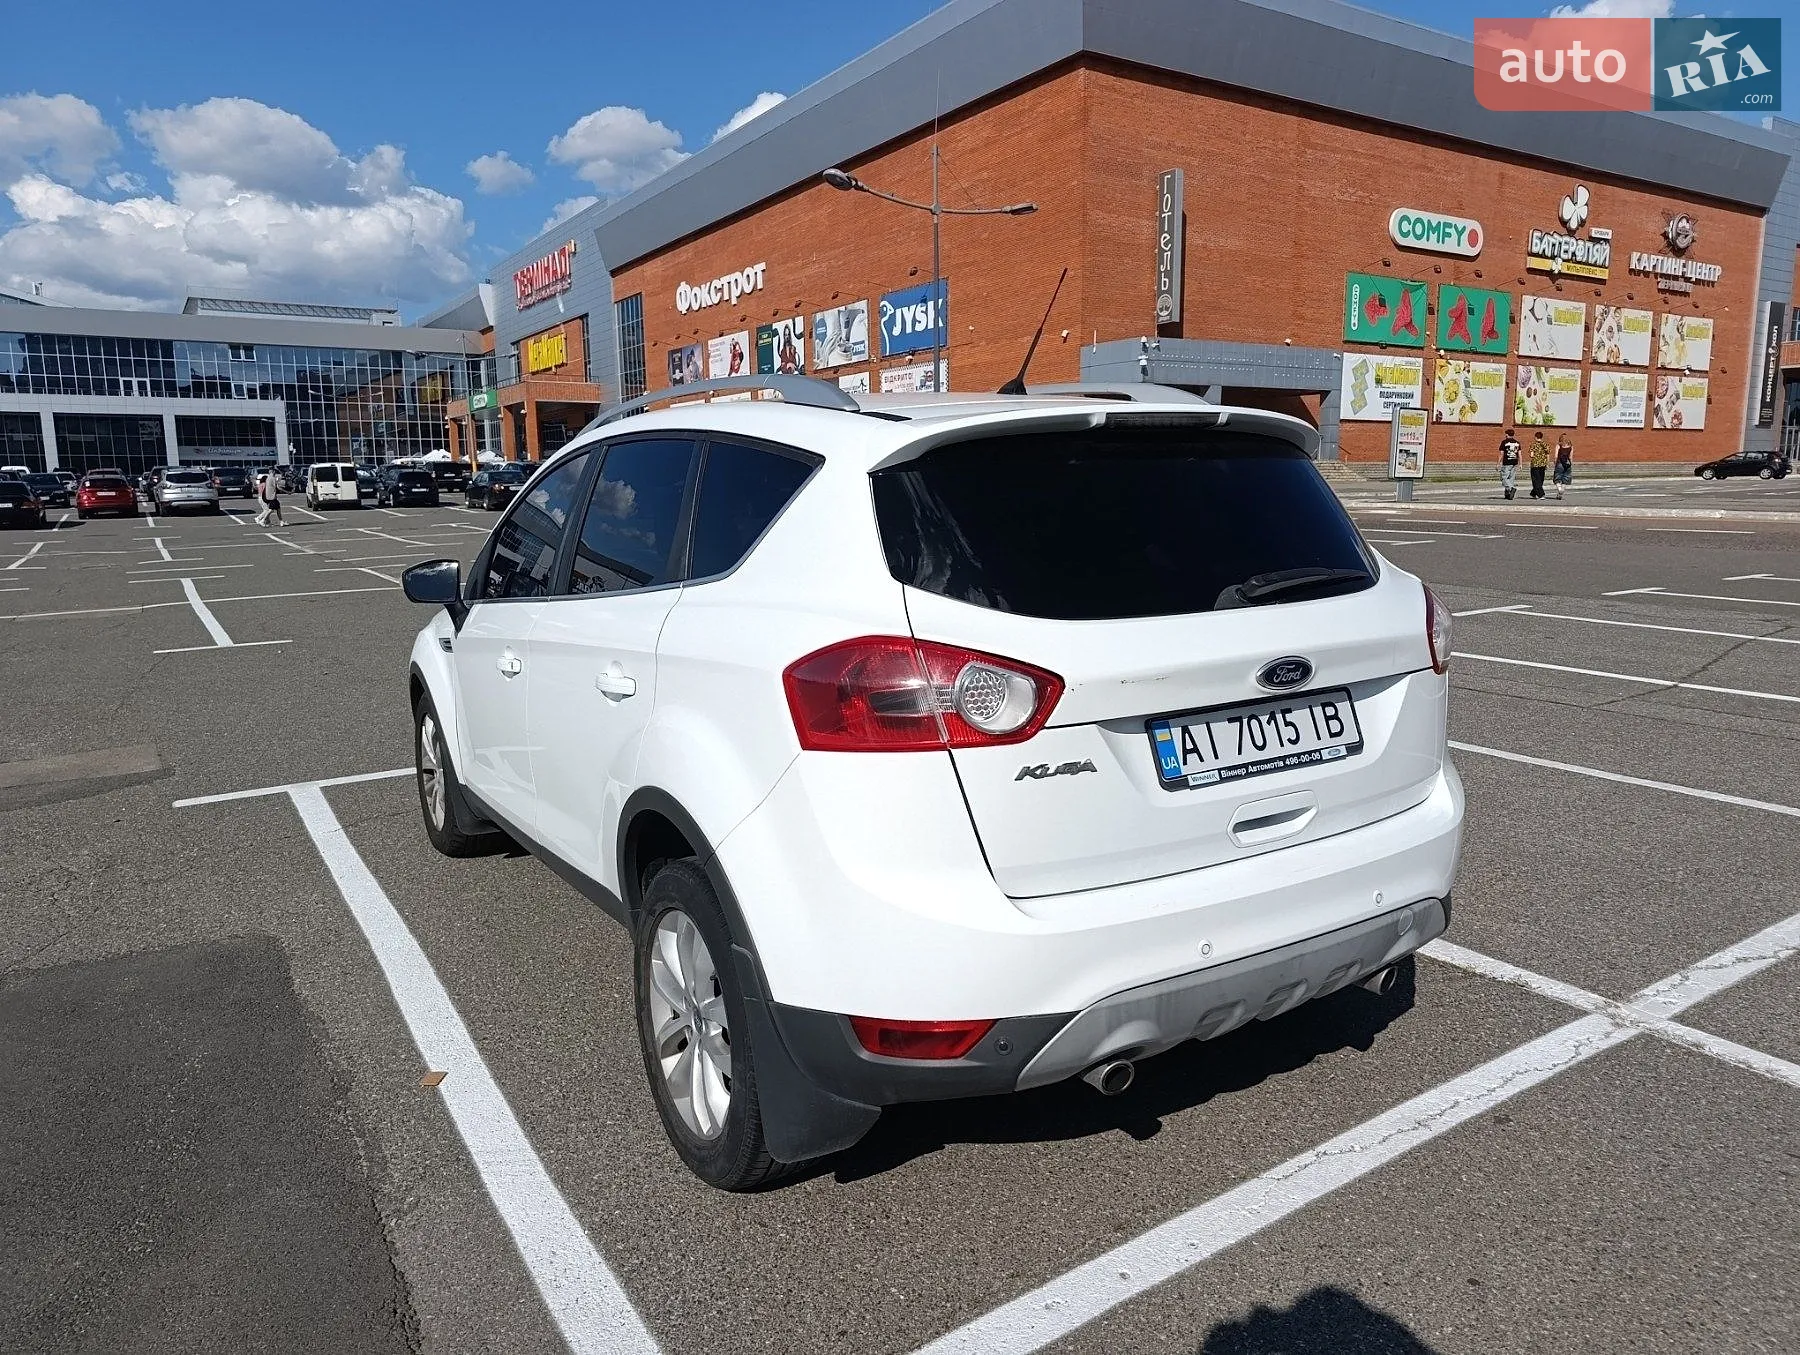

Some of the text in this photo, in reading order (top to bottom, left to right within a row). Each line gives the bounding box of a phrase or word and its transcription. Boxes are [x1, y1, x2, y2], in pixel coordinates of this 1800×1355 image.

[1398, 213, 1467, 247] COMFY
[1530, 229, 1611, 268] БАТТЕРФЛЯЙ
[676, 262, 767, 315] Фокстрот
[1352, 285, 1360, 320] COMFY
[892, 299, 944, 337] JYSK
[1273, 664, 1303, 683] Ford
[1180, 701, 1345, 766] AI 7015 IB
[1014, 758, 1097, 781] KUGA
[1162, 756, 1179, 770] UA
[1220, 767, 1247, 779] Віннер
